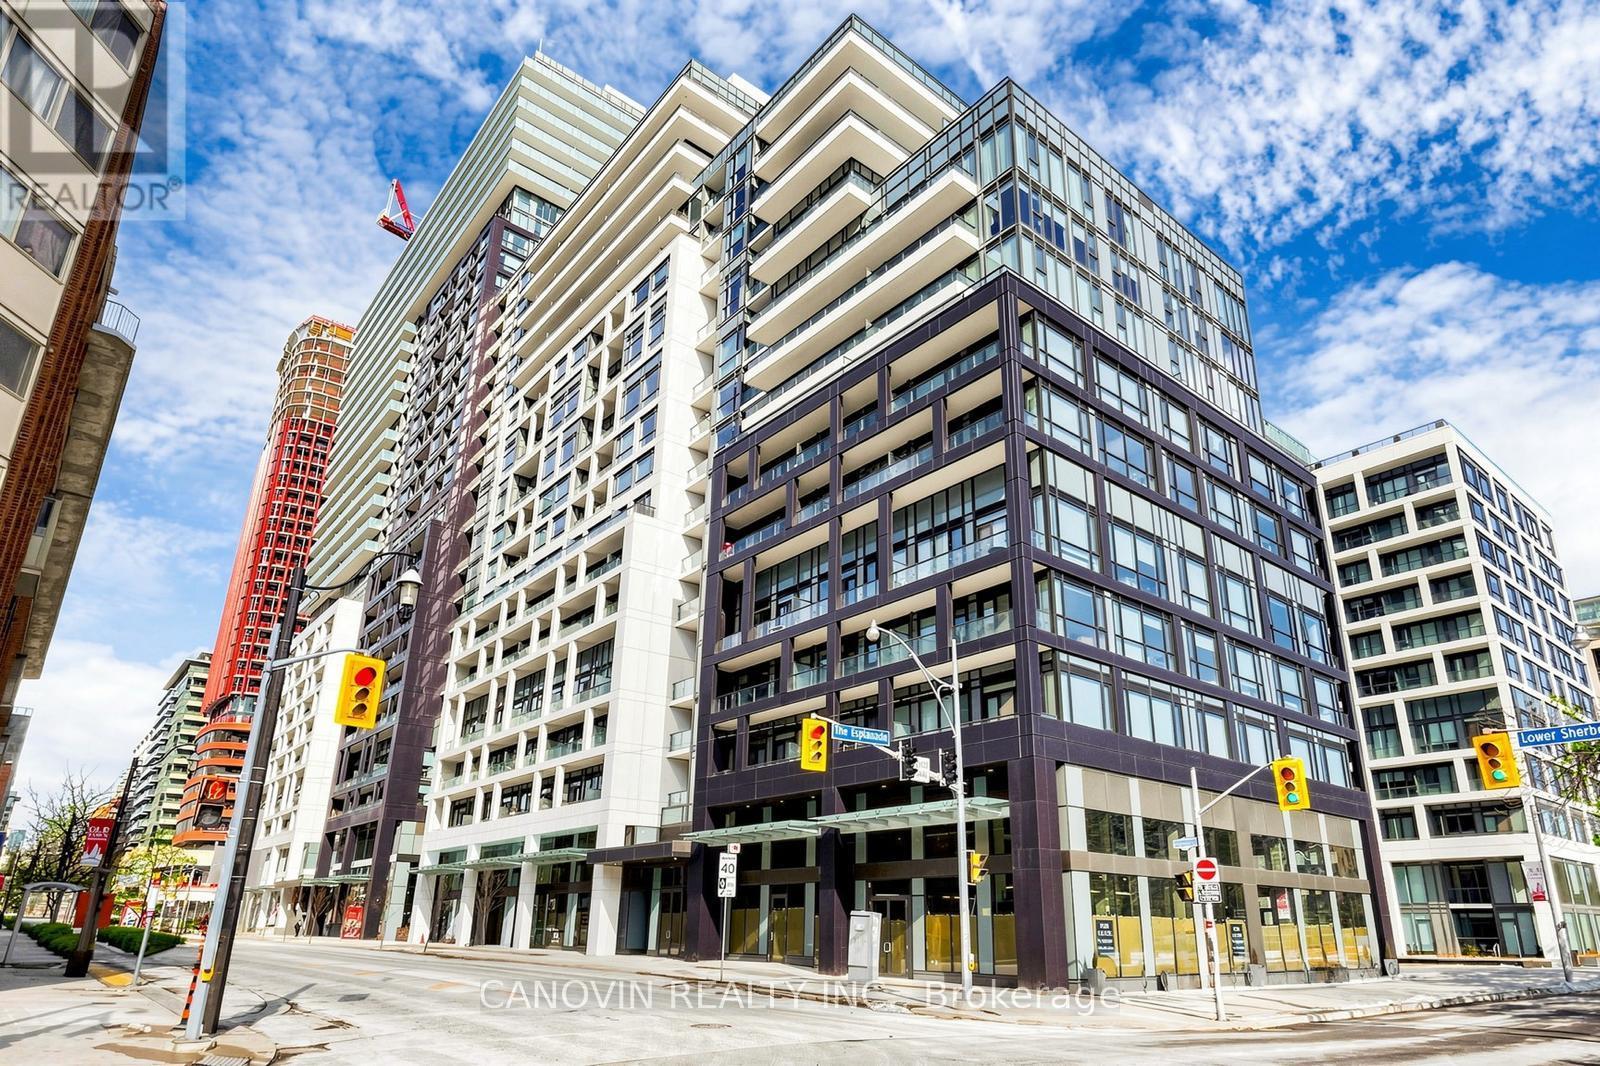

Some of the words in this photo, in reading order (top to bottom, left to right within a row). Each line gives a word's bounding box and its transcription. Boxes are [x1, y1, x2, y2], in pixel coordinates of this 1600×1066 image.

[835, 725, 848, 736] The
[852, 728, 888, 742] Esplanade
[1521, 731, 1555, 744] Lower
[1560, 725, 1600, 739] Sherb
[721, 863, 735, 874] 40
